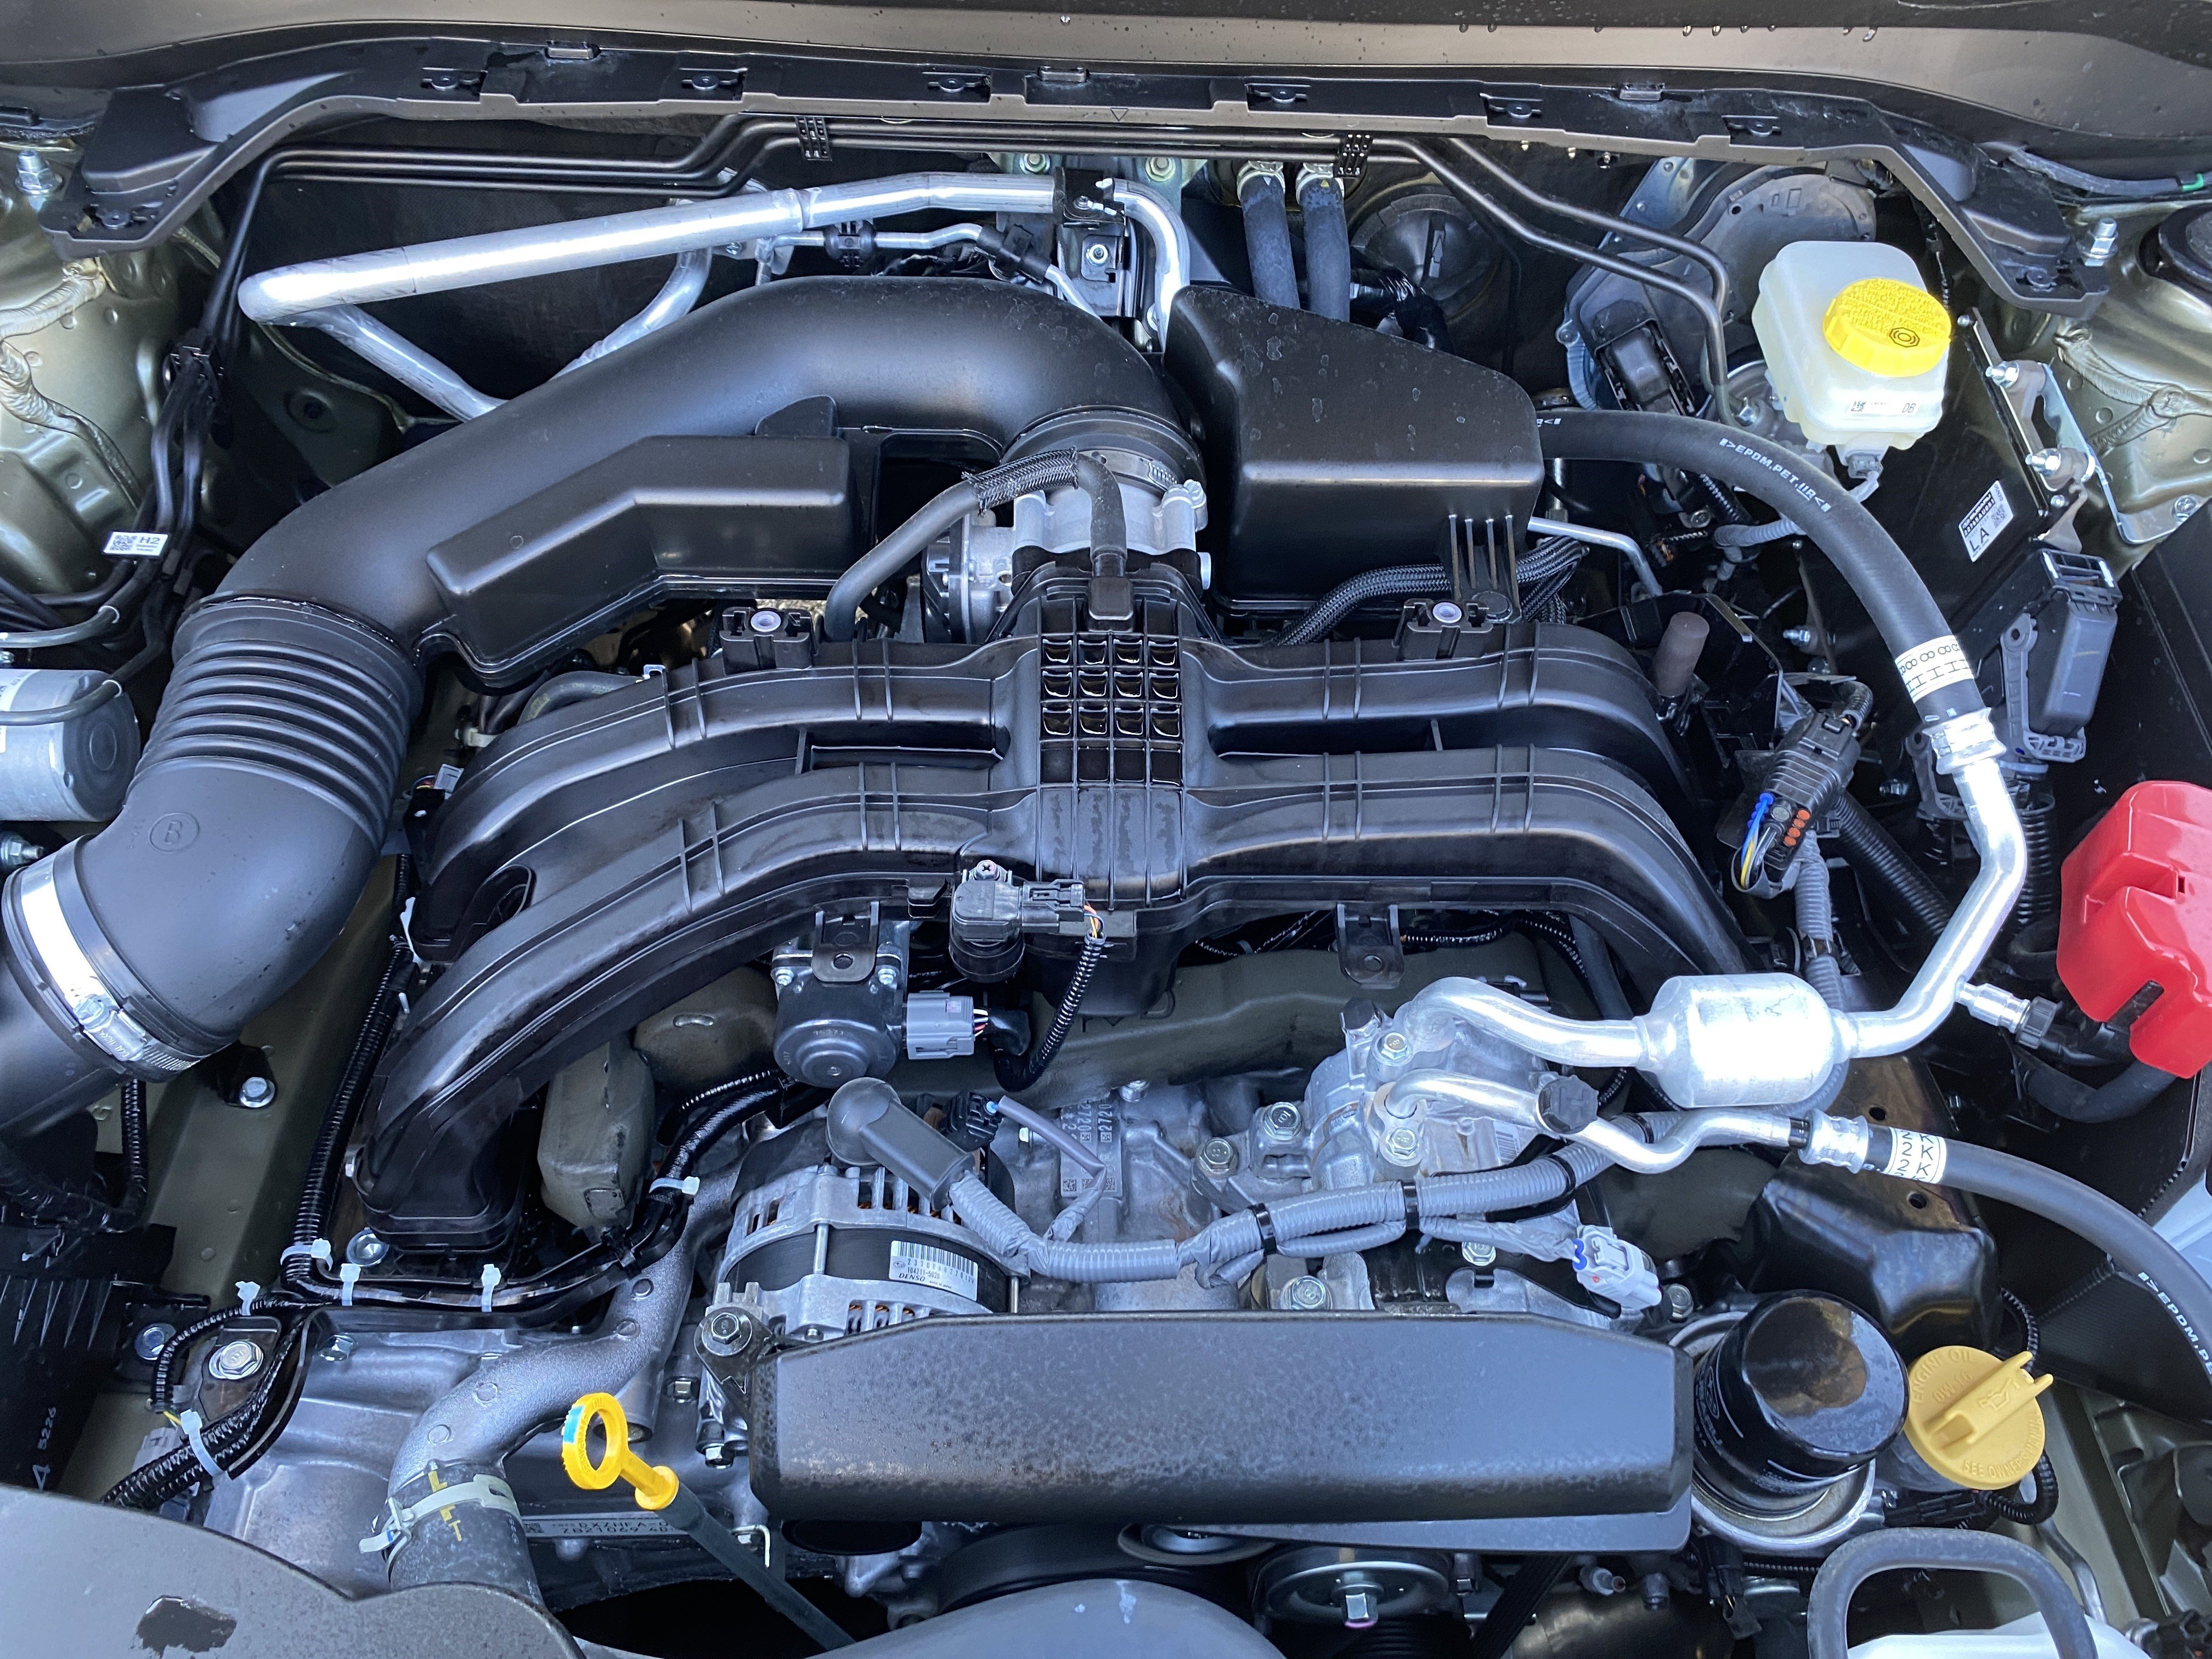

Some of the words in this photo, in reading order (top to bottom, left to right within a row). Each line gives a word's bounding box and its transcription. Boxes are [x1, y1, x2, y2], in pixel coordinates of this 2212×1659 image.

[1902, 403, 1916, 413] DB
[139, 537, 161, 545] H2
[899, 1273, 926, 1282] DENSO
[1911, 1353, 1943, 1403] ENGINE
[1948, 1348, 1976, 1363] OIL
[1963, 1459, 1985, 1478] SEE
